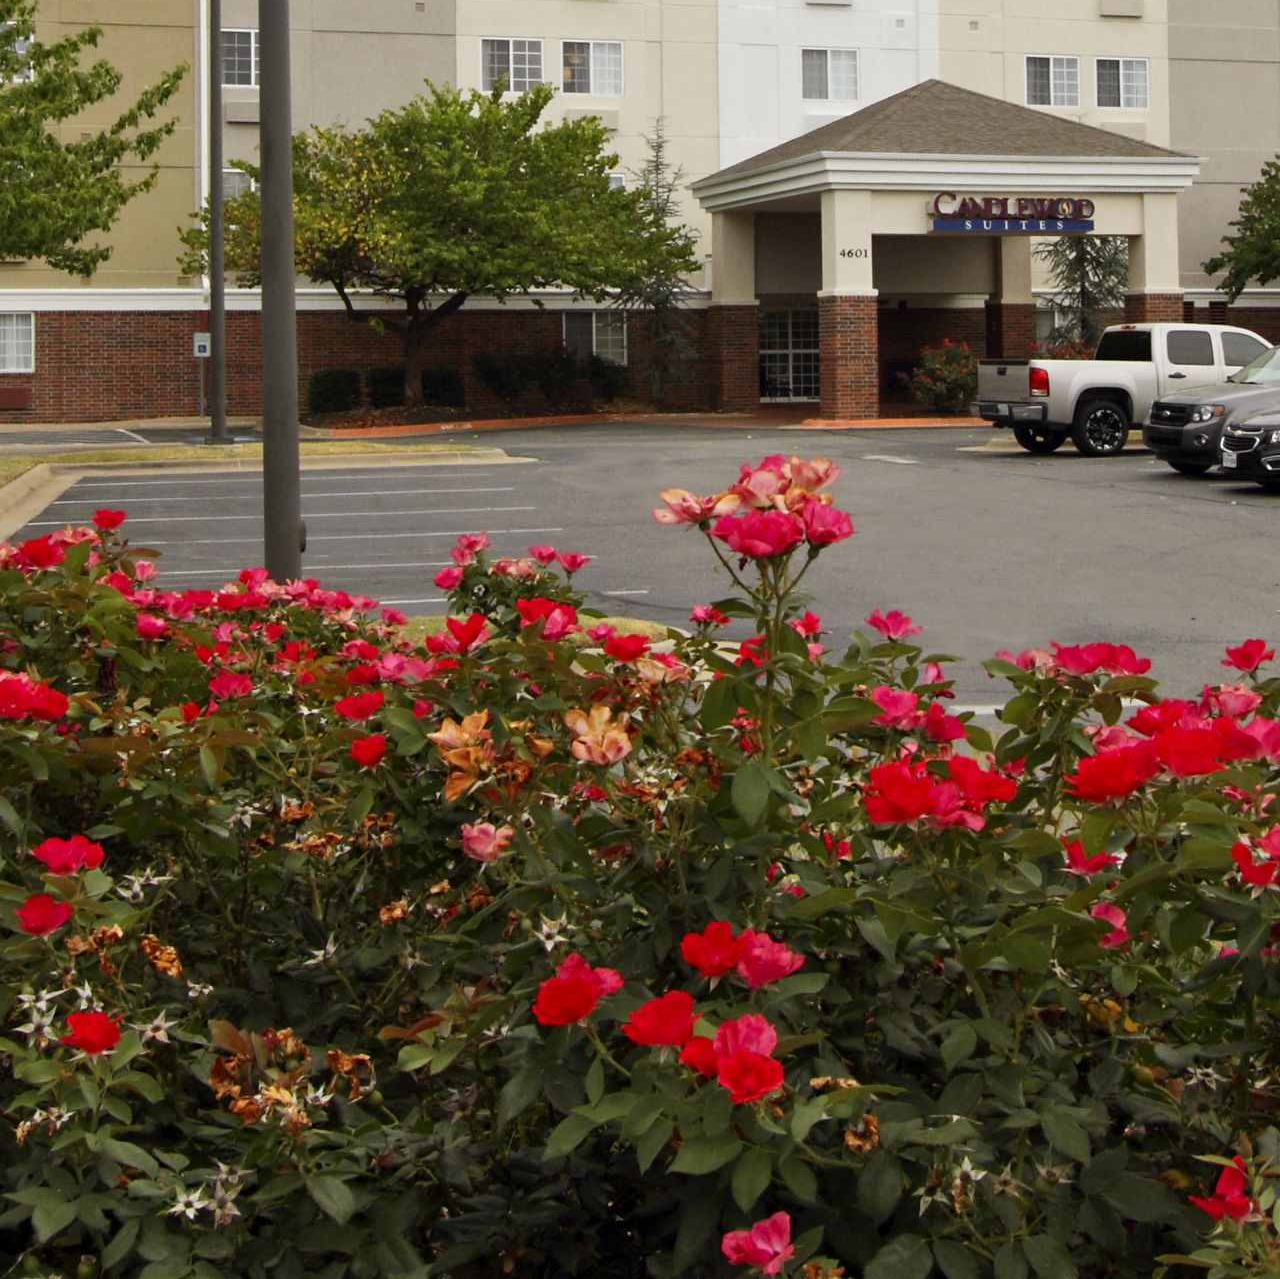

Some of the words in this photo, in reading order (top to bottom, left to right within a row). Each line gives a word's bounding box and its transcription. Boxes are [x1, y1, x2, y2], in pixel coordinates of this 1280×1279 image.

[933, 191, 1095, 219] CANDLEWOOD
[965, 220, 1064, 230] SUITES
[839, 248, 868, 258] 4601
